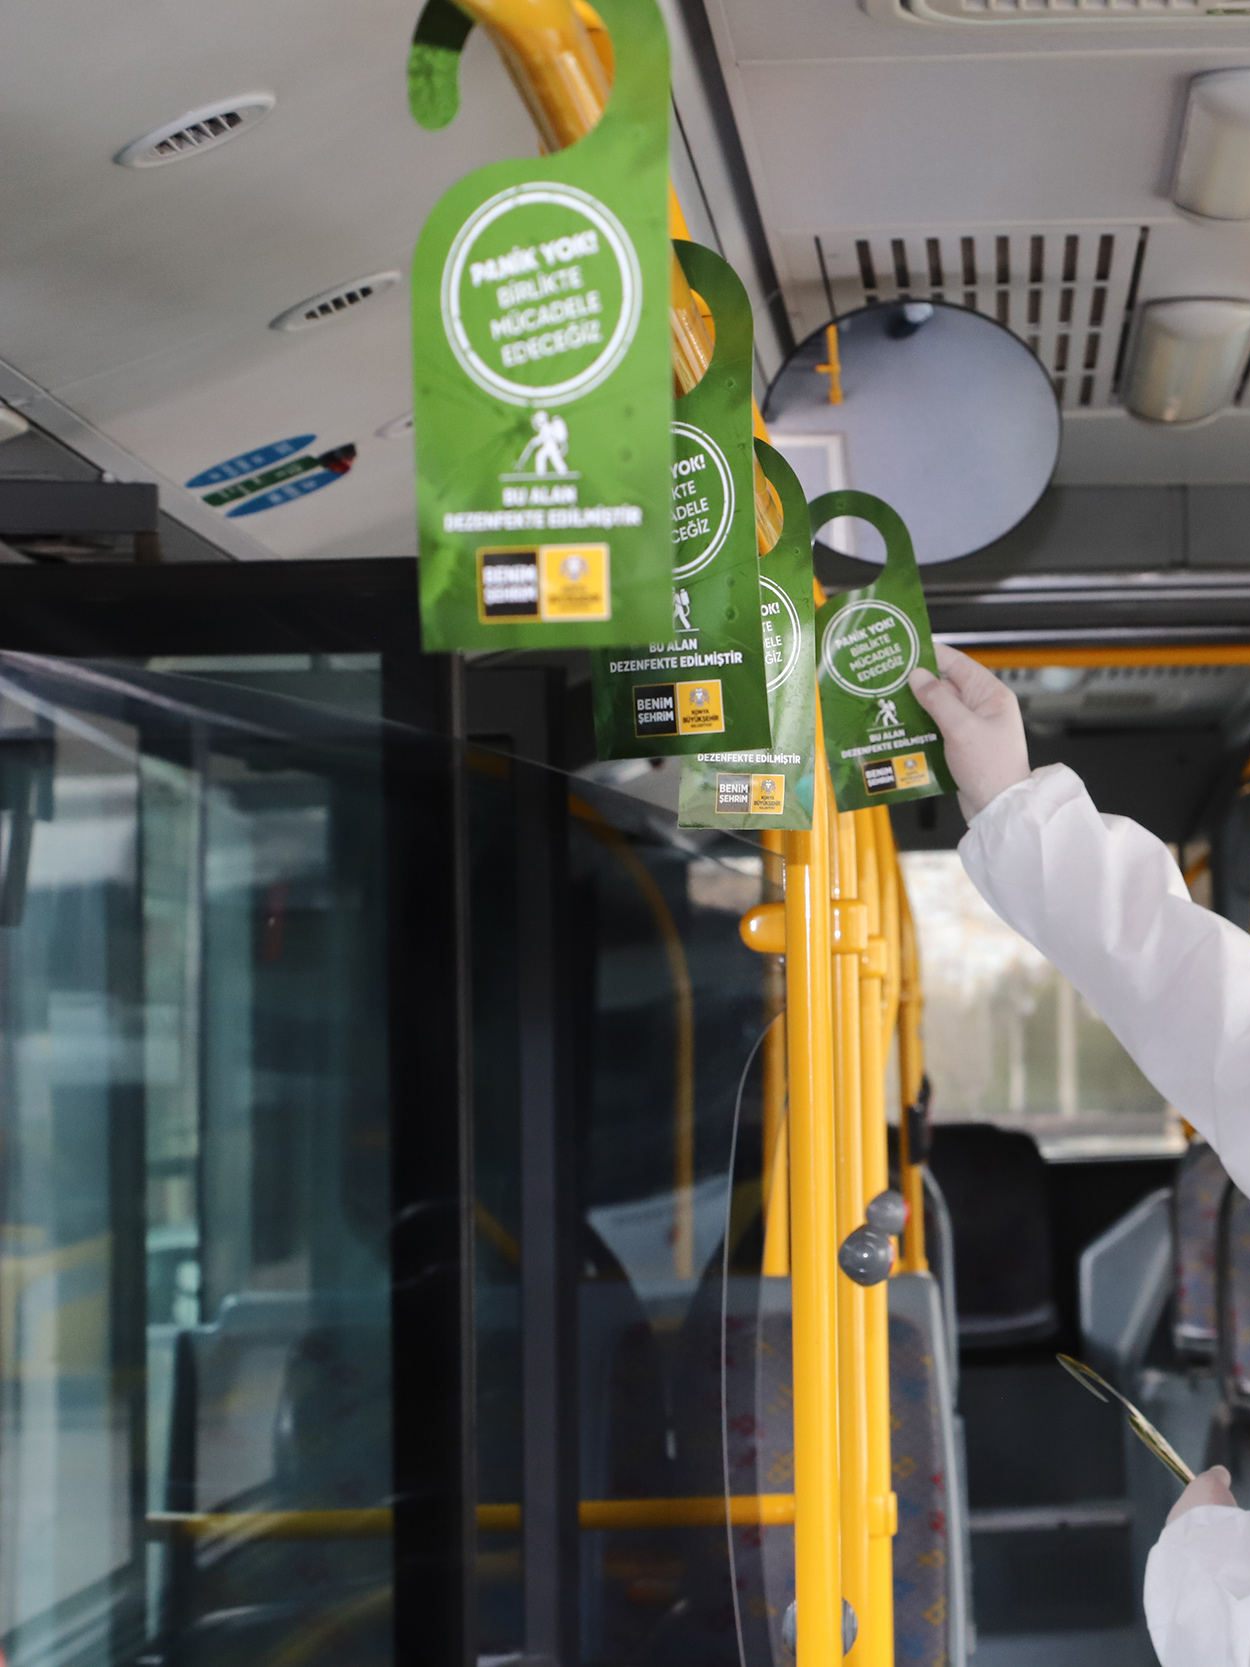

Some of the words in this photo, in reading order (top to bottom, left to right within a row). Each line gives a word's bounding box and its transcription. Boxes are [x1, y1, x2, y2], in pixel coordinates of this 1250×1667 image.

[470, 245, 540, 288] PANİK
[539, 229, 599, 266] YOK!
[496, 265, 584, 310] BİRLİKTE
[489, 289, 603, 341] MÜCADELE
[501, 318, 604, 368] EDECEĞİZ
[502, 486, 529, 508] BU
[529, 485, 578, 506] ALAN
[443, 509, 546, 533] DEZENFEKTE
[761, 602, 780, 617] OK!
[649, 642, 665, 653] BU
[667, 639, 698, 652] ALAN
[609, 657, 678, 673] DEZENFEKTE
[680, 649, 743, 667] EDİLMİŞTİR
[636, 697, 673, 711] BENİM
[638, 710, 675, 725] ŞEHRİM
[697, 753, 754, 763] DEZENFEKTE
[756, 752, 801, 765] EDİLMİŞTİR
[719, 783, 749, 793] BENİM
